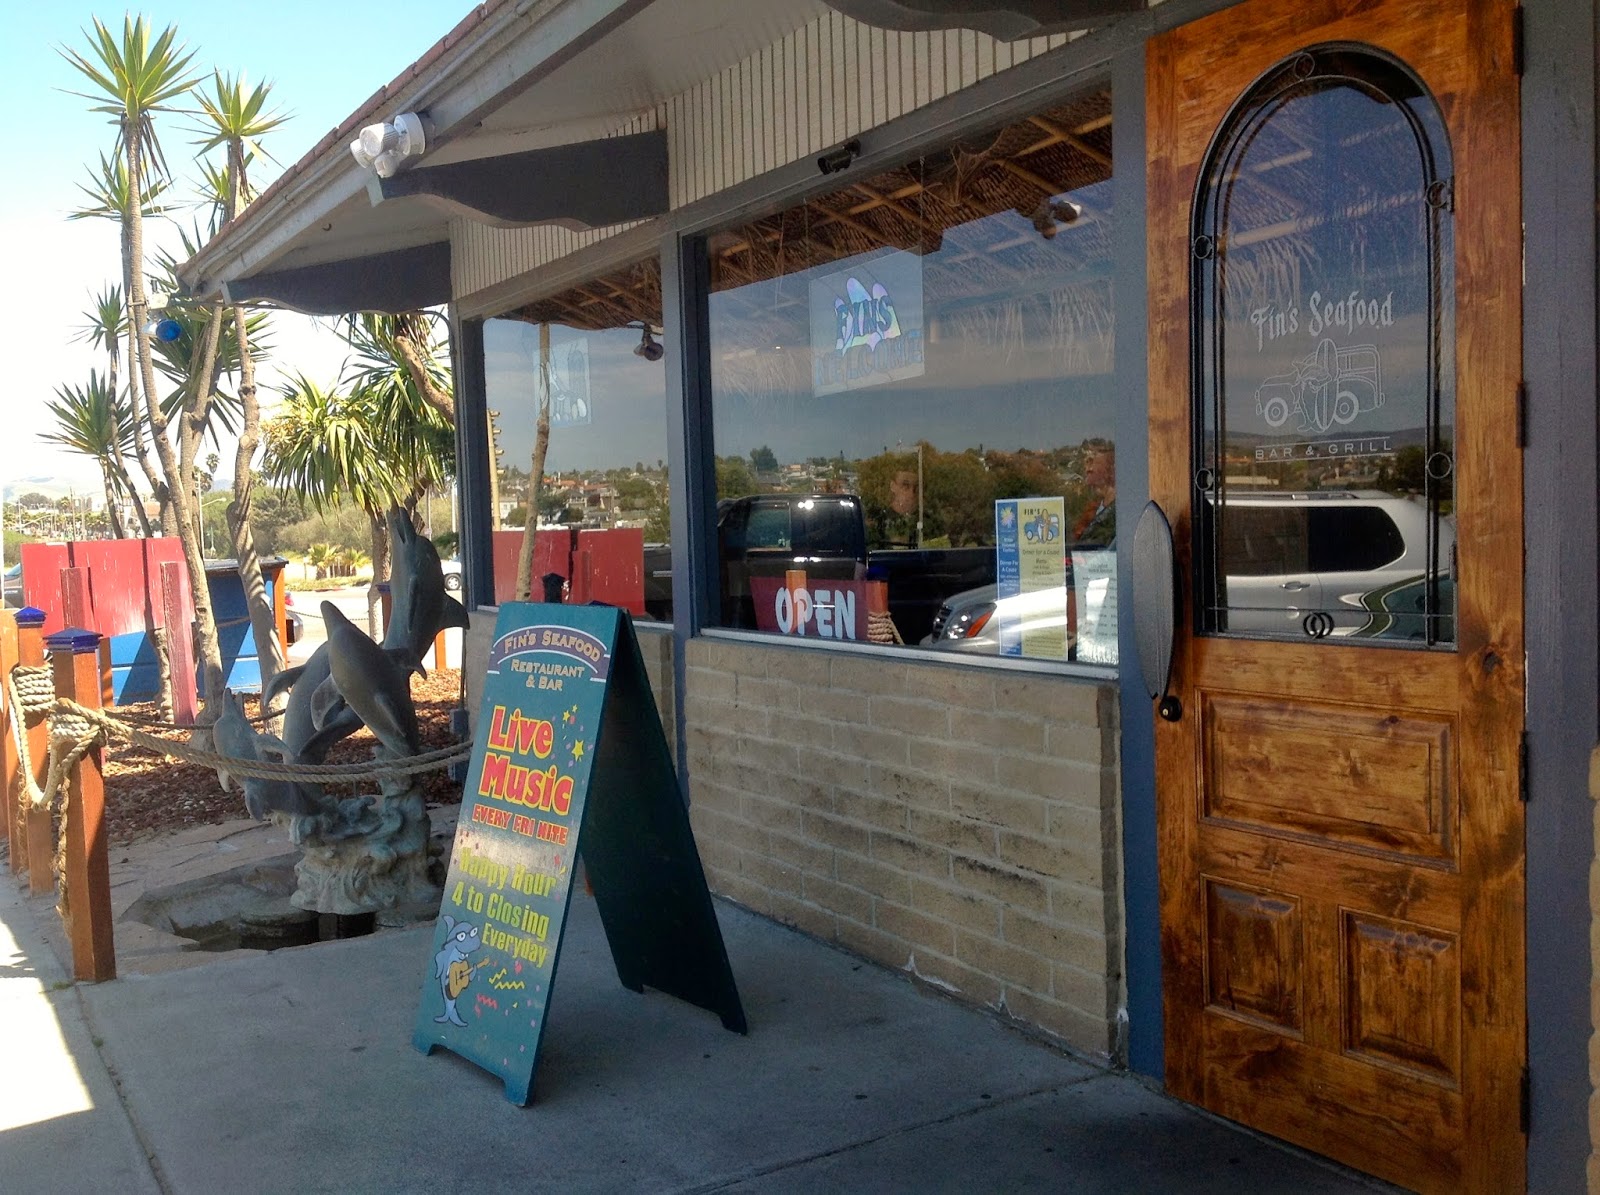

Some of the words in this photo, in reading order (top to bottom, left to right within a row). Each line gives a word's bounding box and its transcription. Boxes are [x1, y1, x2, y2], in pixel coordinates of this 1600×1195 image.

[1251, 299, 1299, 352] Fin's
[1308, 291, 1395, 337] Seafood
[1255, 447, 1293, 459] BAR
[1305, 445, 1315, 456] &
[1328, 440, 1392, 454] GRILL
[774, 586, 856, 640] OPEN
[503, 630, 537, 654] FIN'S
[541, 630, 601, 662] SEAFOOD
[511, 659, 585, 678] RESTAURANT
[525, 674, 535, 689] &
[538, 676, 563, 691] BAR
[487, 705, 553, 759] Live
[478, 751, 575, 816] Music
[472, 803, 513, 830] EVERY
[512, 814, 536, 837] FRI
[536, 820, 569, 847] NITE
[458, 847, 509, 890] Happy
[511, 863, 557, 898] Hour
[451, 881, 465, 906] 4
[466, 885, 484, 914] to
[486, 892, 550, 942] Closing
[481, 922, 548, 968] Everyday
